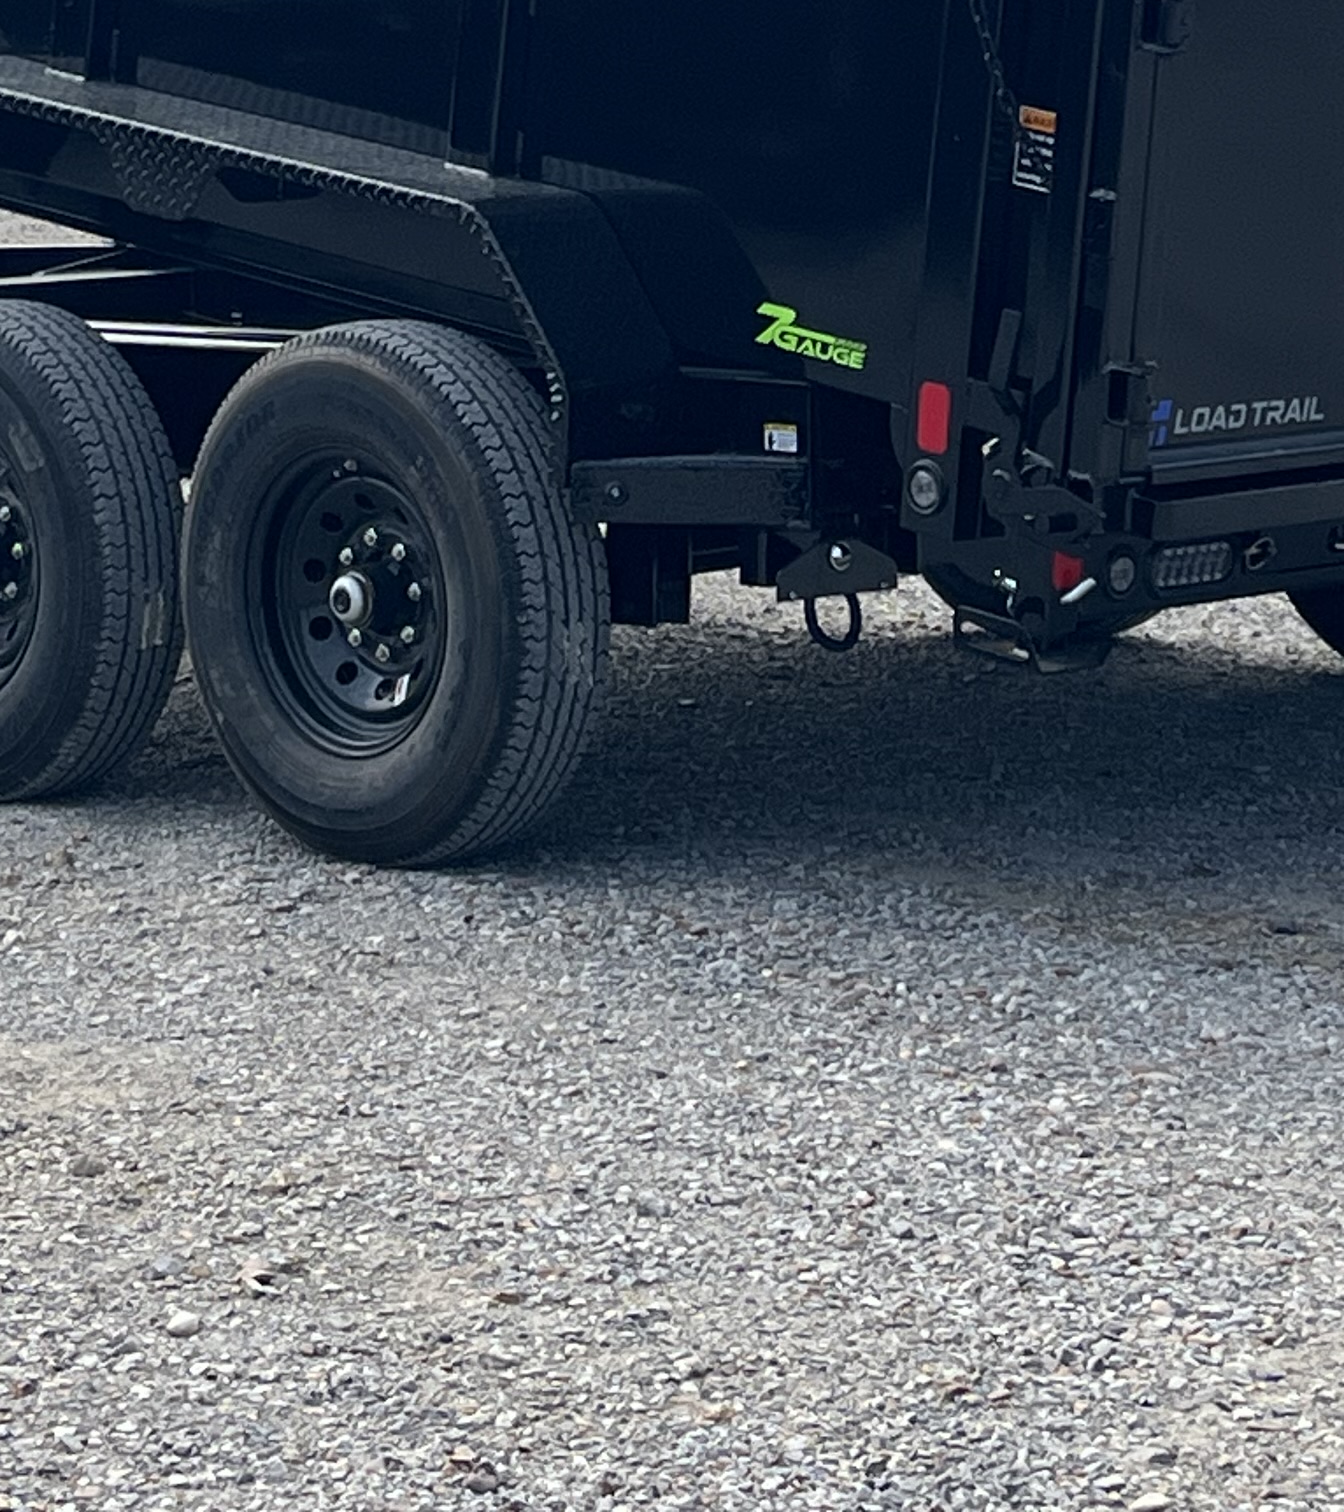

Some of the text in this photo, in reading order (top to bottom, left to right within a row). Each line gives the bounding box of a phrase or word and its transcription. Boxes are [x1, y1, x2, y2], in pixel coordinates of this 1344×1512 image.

[754, 301, 866, 370] 7 GAUGE
[1172, 395, 1325, 435] LOAD TRAIL
